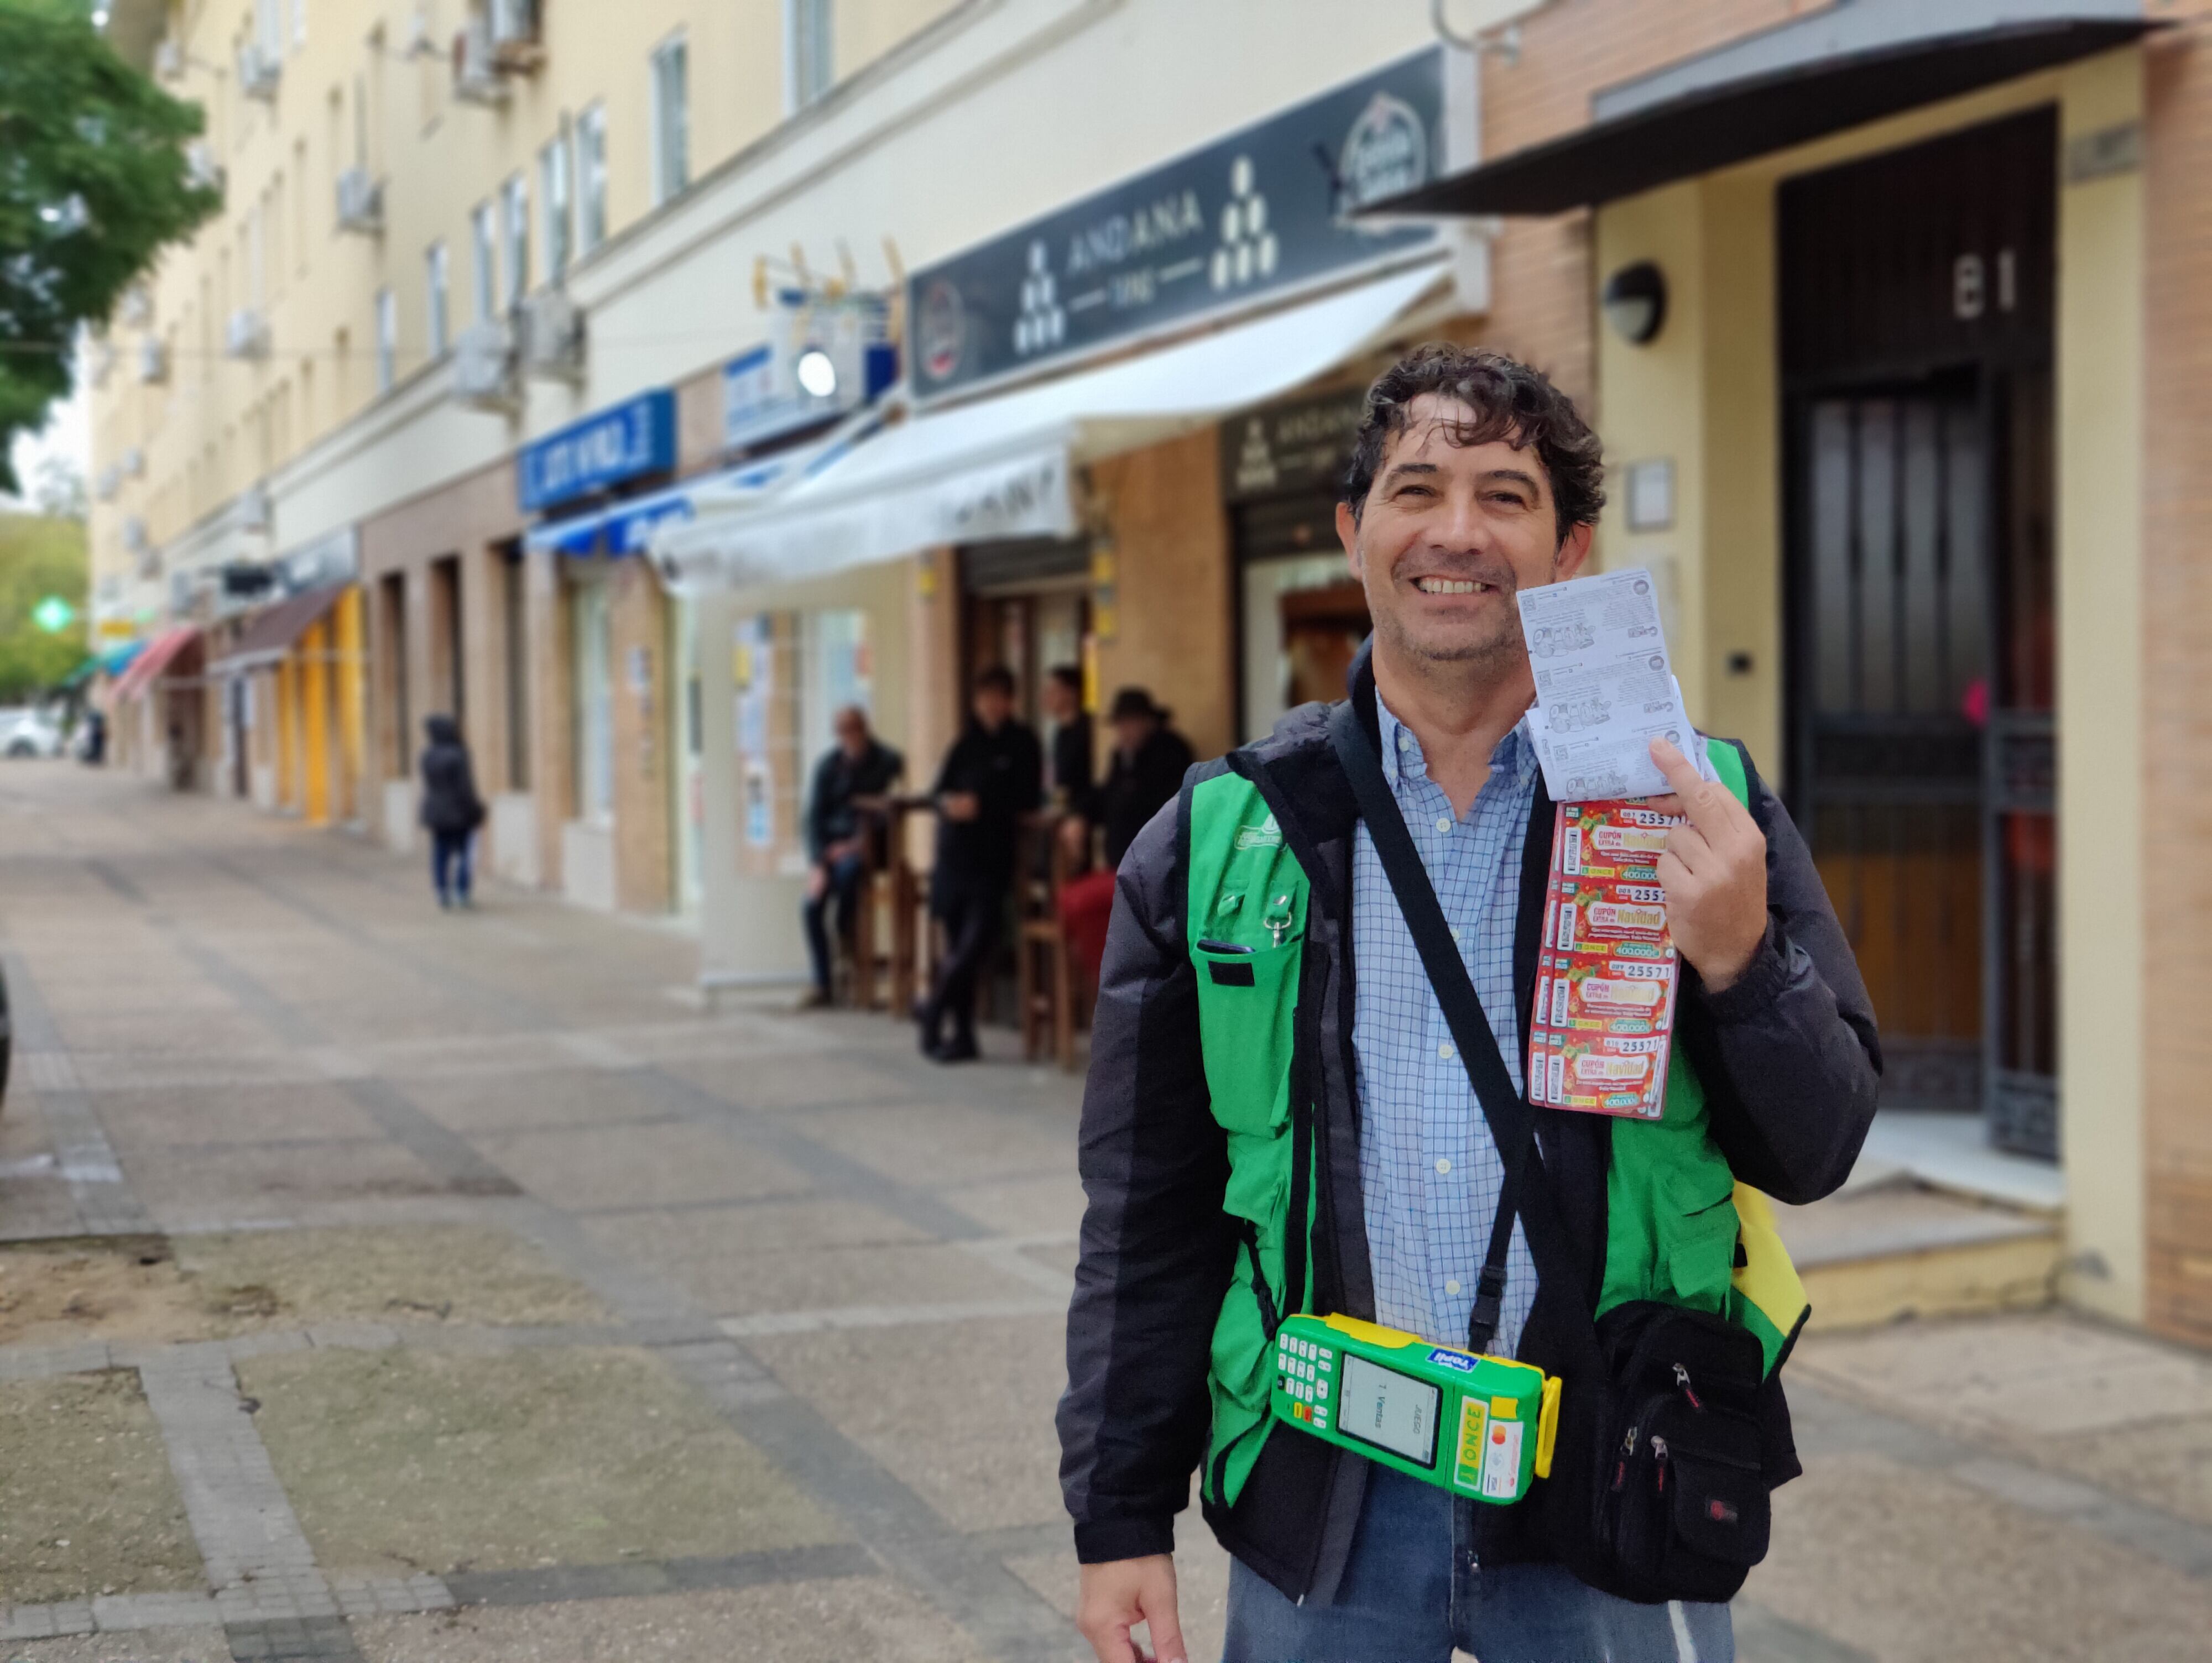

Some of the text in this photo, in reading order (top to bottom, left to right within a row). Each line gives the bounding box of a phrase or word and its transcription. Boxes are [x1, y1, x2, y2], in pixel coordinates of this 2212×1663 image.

[1066, 188, 1203, 276] ANDANA
[1618, 909, 1661, 924] Navidad
[1628, 965, 1669, 977] 25571
[1623, 1039, 1657, 1052] 25571
[1375, 1396, 1385, 1429] Ventas
[1413, 1404, 1421, 1435] JUEGO
[1463, 1406, 1481, 1461] ONCE
